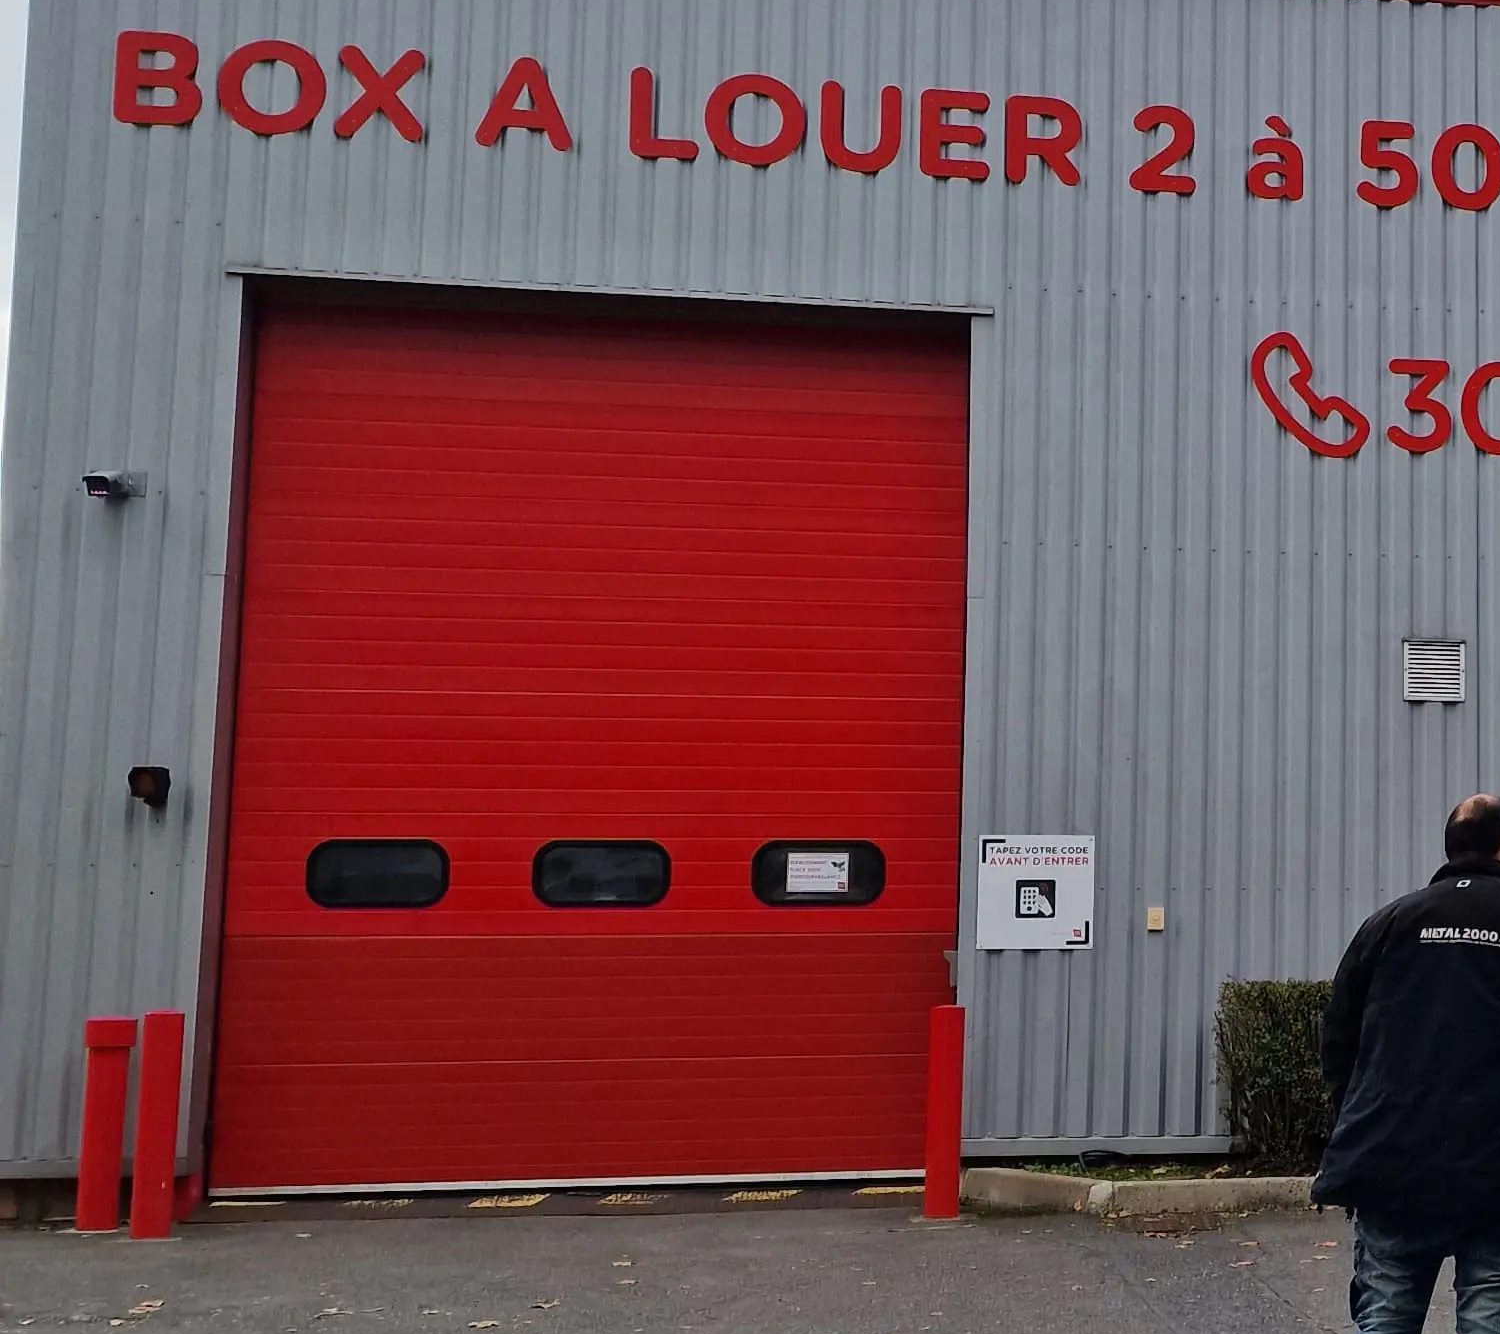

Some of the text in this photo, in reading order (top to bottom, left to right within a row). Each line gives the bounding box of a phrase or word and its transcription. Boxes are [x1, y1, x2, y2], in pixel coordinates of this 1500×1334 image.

[113, 30, 425, 141] BOX
[475, 57, 573, 151] A
[629, 67, 1082, 187] LOUER
[1129, 105, 1196, 194] 2
[1246, 115, 1304, 201] à
[990, 846, 1089, 855] TAPEZ VOTRE CODE
[989, 856, 1089, 866] AVANT D'ENTRER
